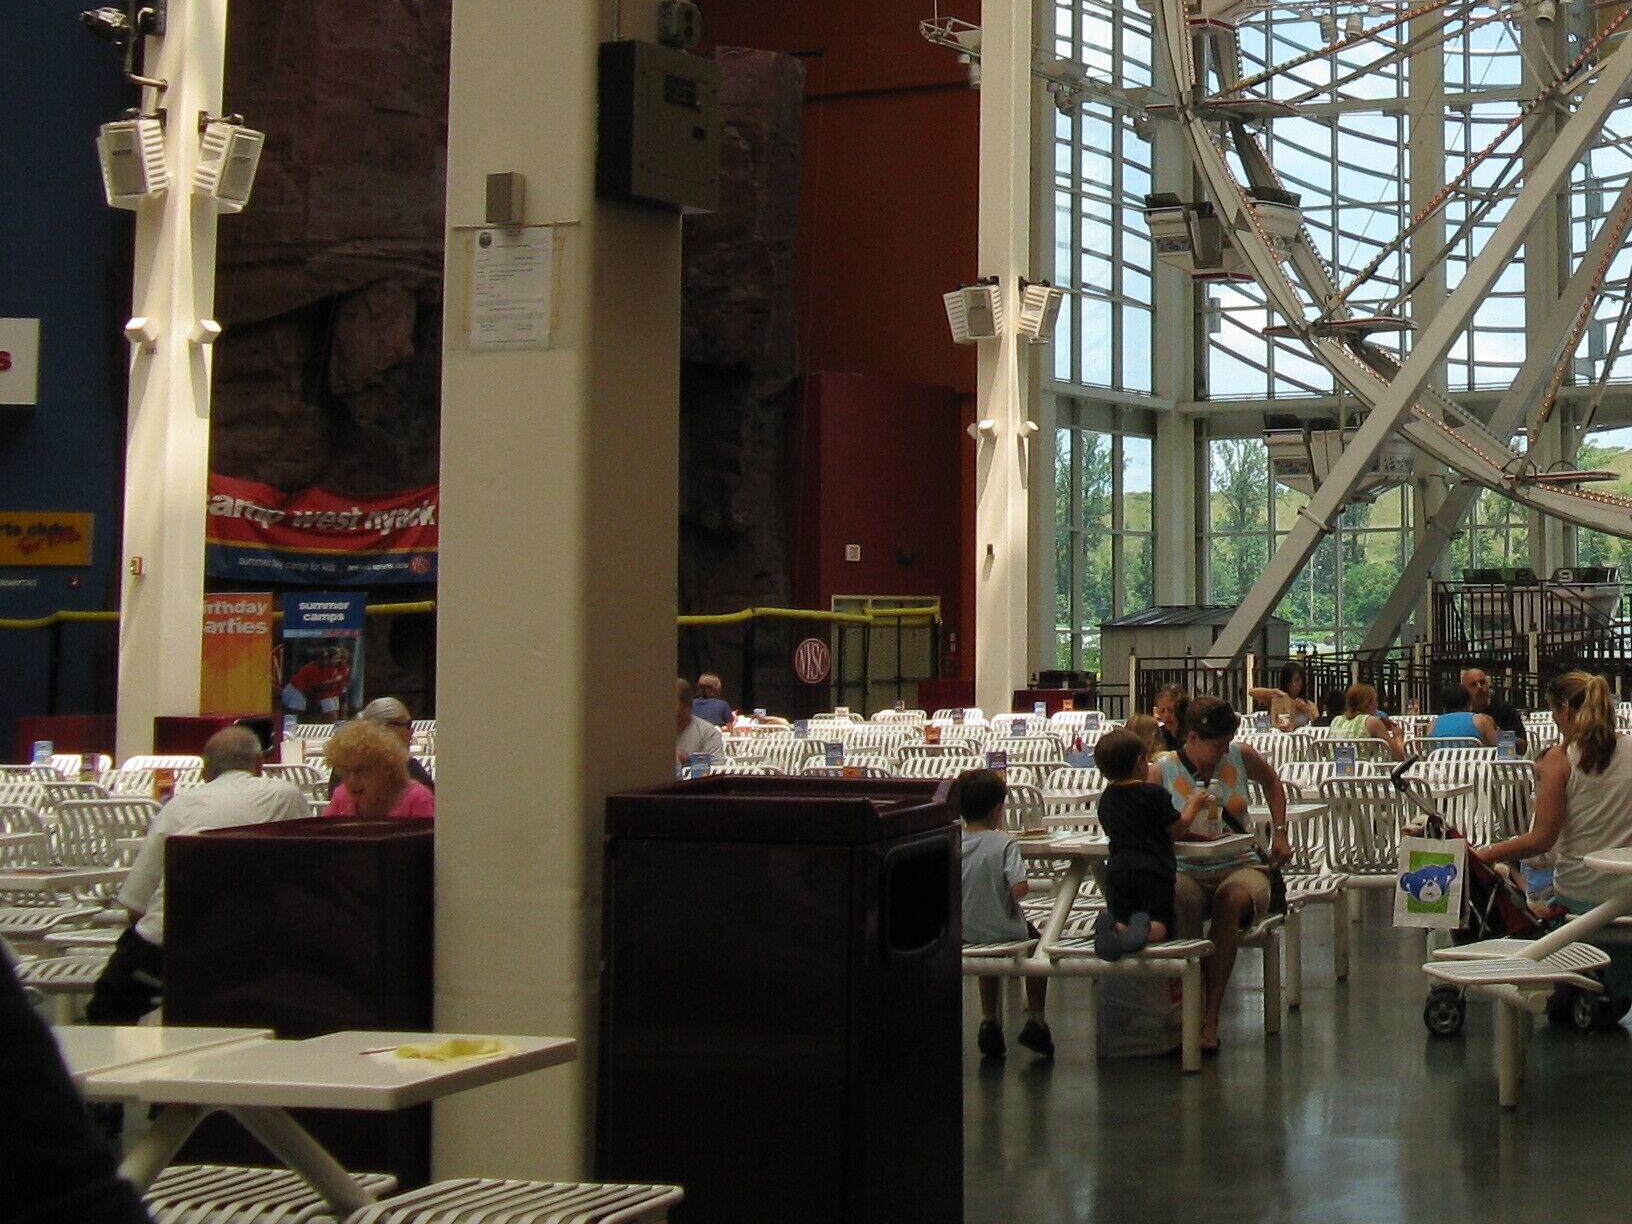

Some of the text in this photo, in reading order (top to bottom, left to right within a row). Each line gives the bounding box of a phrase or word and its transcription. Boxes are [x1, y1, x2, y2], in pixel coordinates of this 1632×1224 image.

[208, 493, 287, 529] amp
[293, 507, 363, 531] west
[203, 600, 268, 616] irthday
[298, 601, 350, 611] summer
[302, 612, 346, 624] camps
